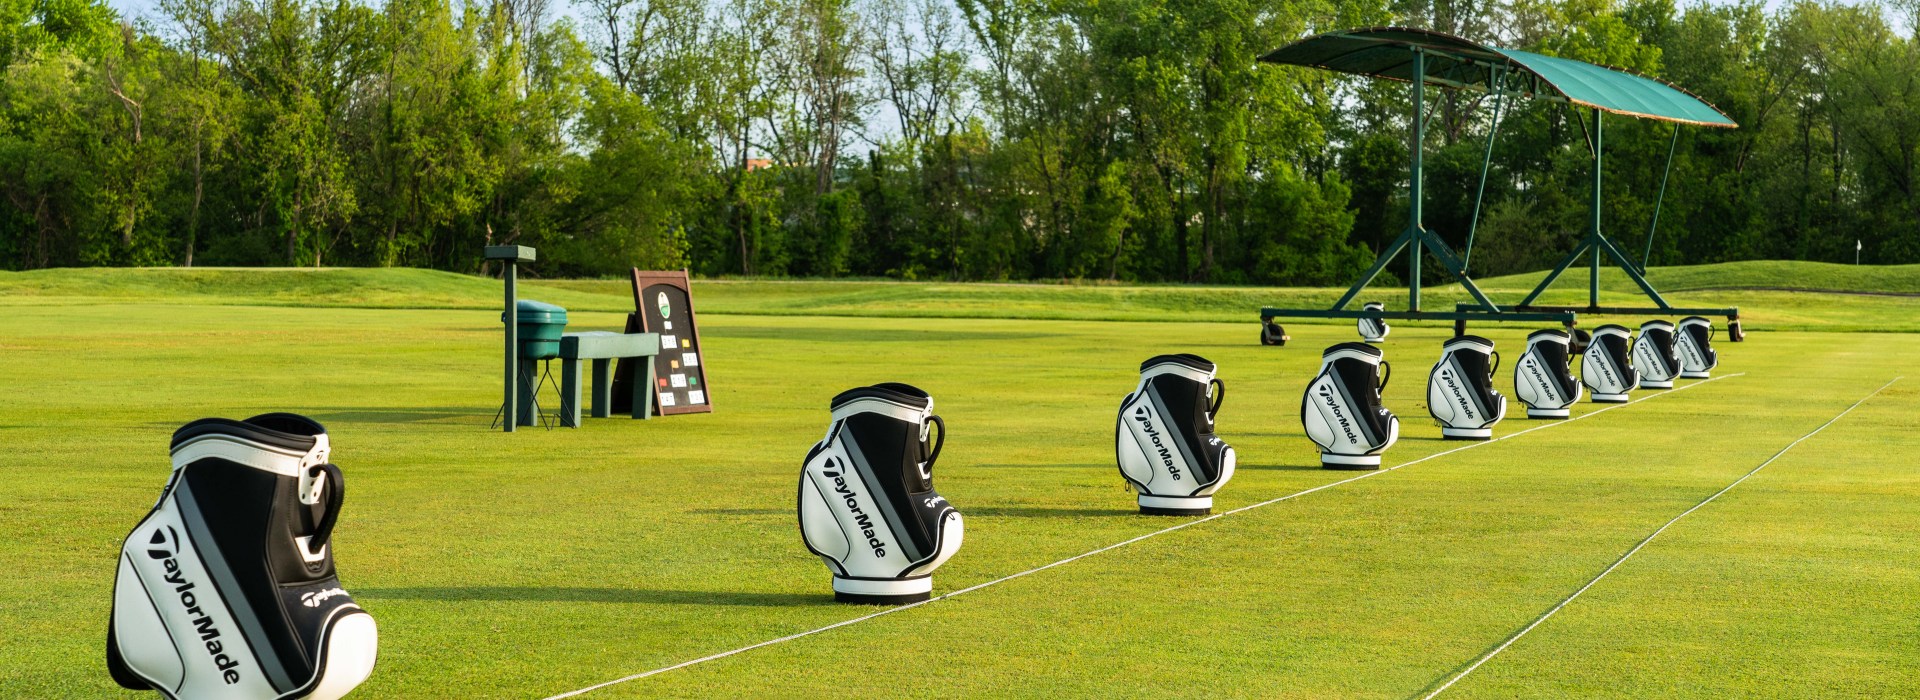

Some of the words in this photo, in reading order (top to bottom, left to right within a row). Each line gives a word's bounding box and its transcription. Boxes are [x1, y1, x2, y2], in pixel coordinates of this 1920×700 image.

[1526, 358, 1555, 401] TaylorMade
[1591, 349, 1616, 387] TaylorMade
[1640, 342, 1661, 375] TaylorMade
[1319, 383, 1358, 445] TaylorMade
[1441, 368, 1474, 420] TaylorMade
[1134, 405, 1181, 481] TaylorMade
[822, 455, 886, 559] TaylorMade
[147, 524, 241, 686] TaylorMade
